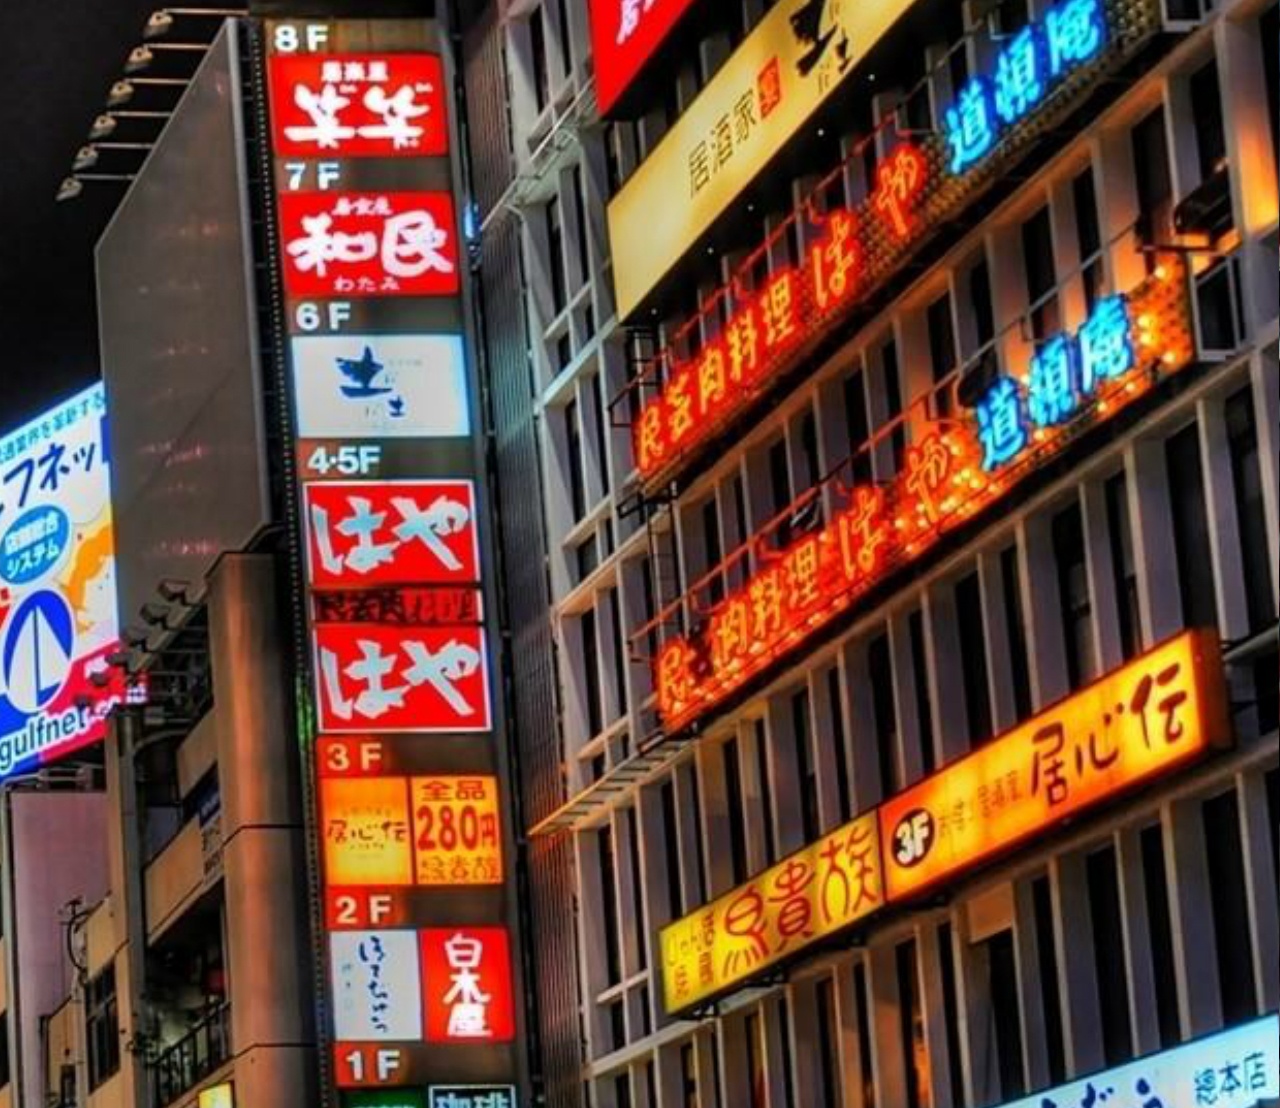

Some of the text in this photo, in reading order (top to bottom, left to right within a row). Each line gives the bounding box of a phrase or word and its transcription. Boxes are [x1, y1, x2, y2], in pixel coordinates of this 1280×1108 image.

[285, 210, 455, 279] 和民
[333, 275, 400, 292] わたみ
[310, 495, 471, 576] はや
[319, 638, 481, 721] はや
[326, 742, 382, 772] 3F
[1028, 661, 1187, 811] 居心伝
[421, 780, 486, 802] 全品
[416, 804, 497, 852] 280円
[896, 810, 930, 865] 3F
[336, 895, 391, 925] 2F
[721, 826, 885, 979] 鳥貴族
[442, 932, 494, 1038] 白木屋
[345, 1049, 400, 1081] 1F
[1193, 1050, 1269, 1107] 総本店
